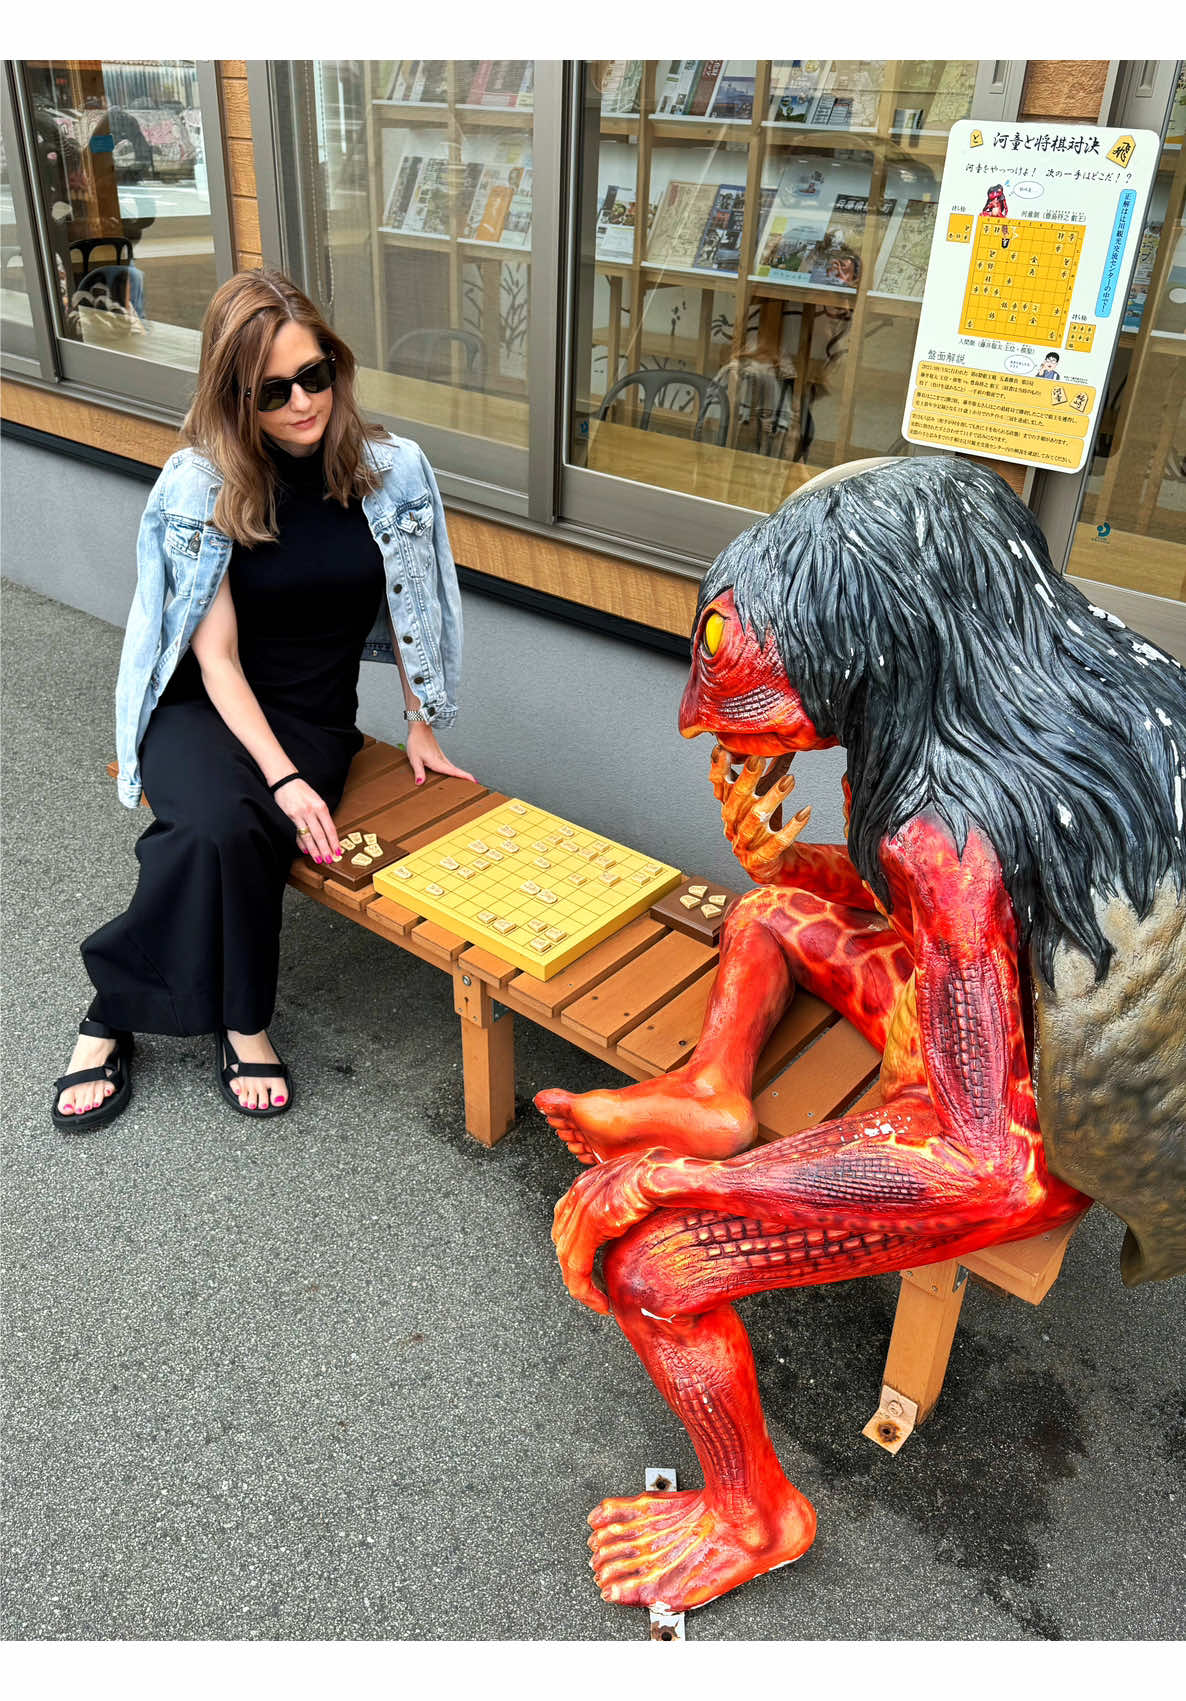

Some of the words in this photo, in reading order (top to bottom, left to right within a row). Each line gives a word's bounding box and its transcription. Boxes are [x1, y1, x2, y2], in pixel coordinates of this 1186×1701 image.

[973, 134, 980, 144] と
[993, 132, 1101, 155] 河童と将棋対決
[1112, 142, 1132, 163] 飛
[965, 162, 1037, 177] 河童をやっつけよ！
[1045, 168, 1133, 183] 次の一手はどこだ！？
[927, 349, 966, 365] 盤面解説
